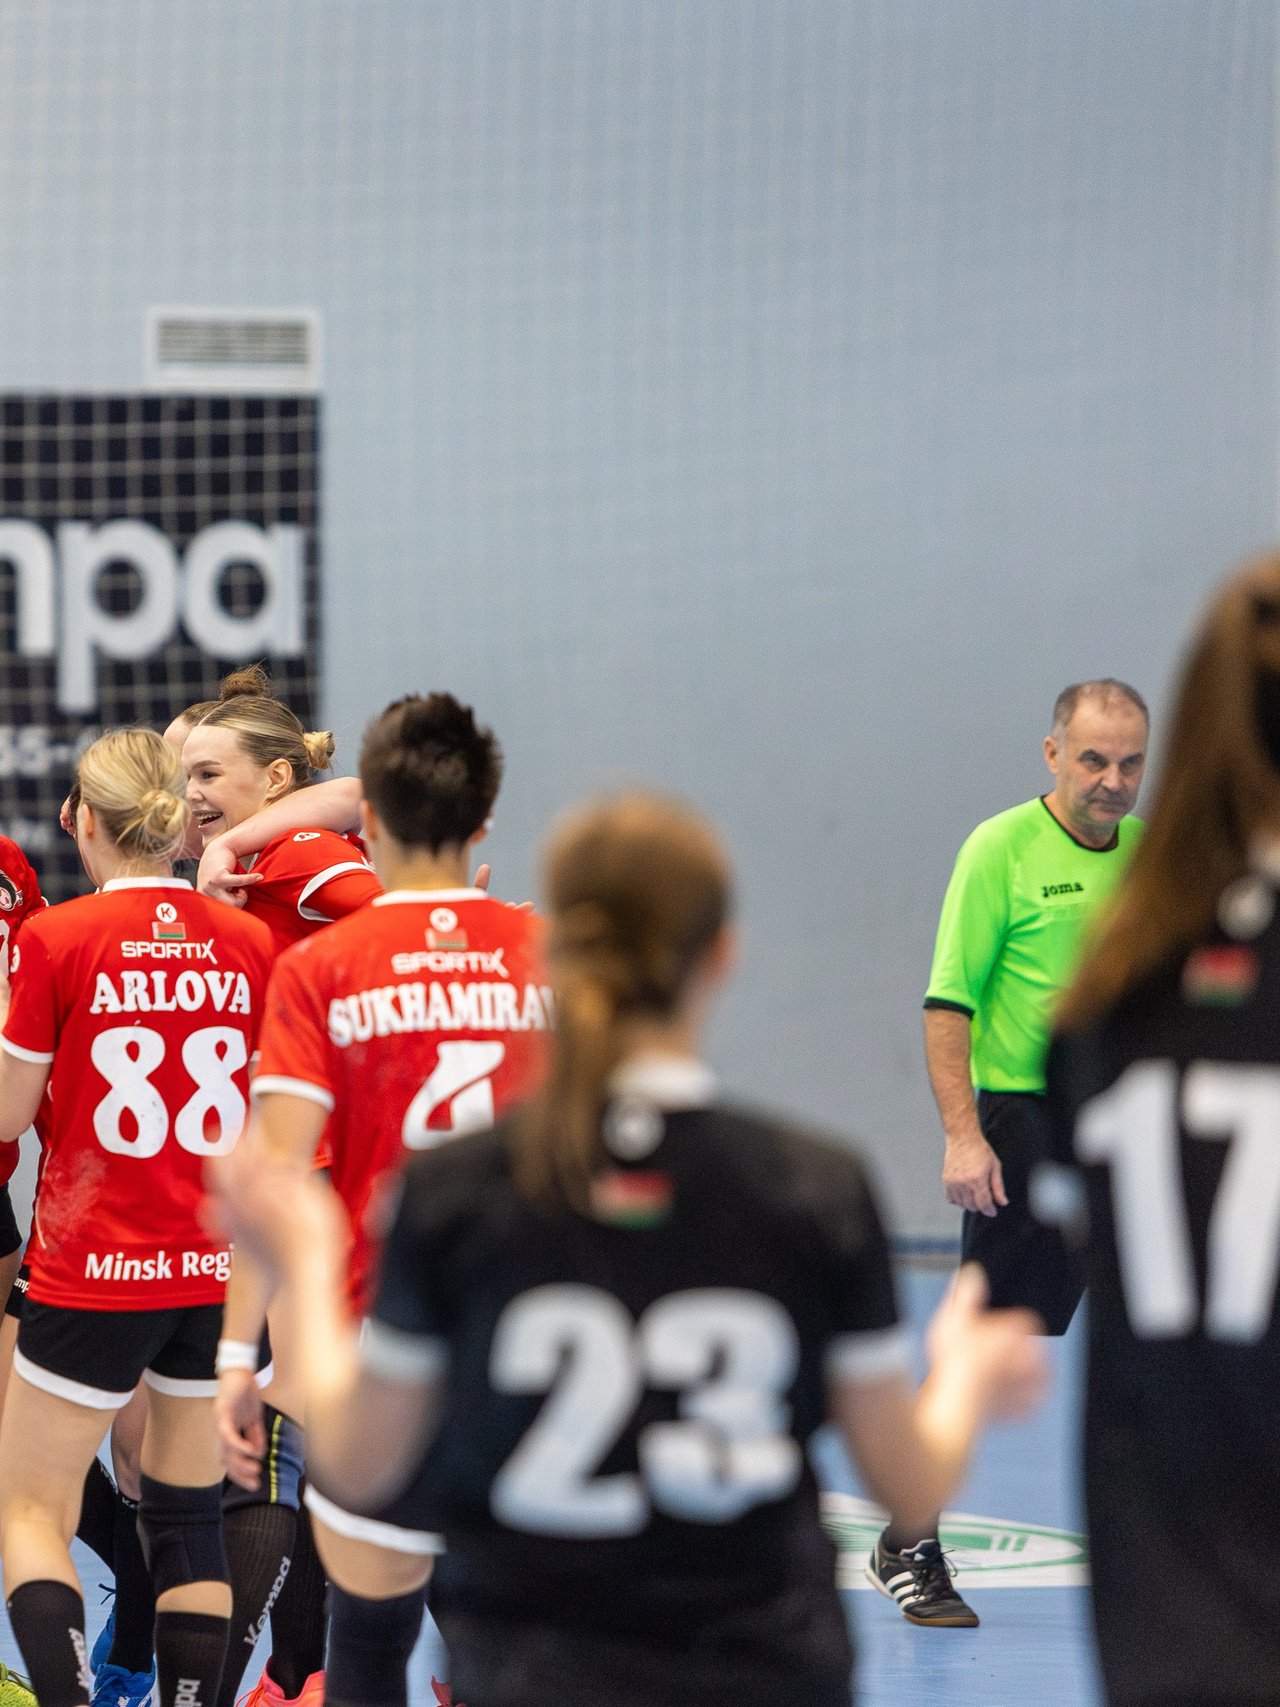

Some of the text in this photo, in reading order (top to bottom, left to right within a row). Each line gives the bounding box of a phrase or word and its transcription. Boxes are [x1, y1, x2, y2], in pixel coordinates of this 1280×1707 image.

[120, 938, 218, 965] SPORTIX
[390, 947, 510, 978] SPORTIX
[89, 970, 251, 1014] ARLOVA
[90, 1025, 249, 1160] 88
[1072, 1055, 1280, 1348] 17
[84, 1250, 173, 1281] Minsk
[487, 1281, 805, 1540] 23
